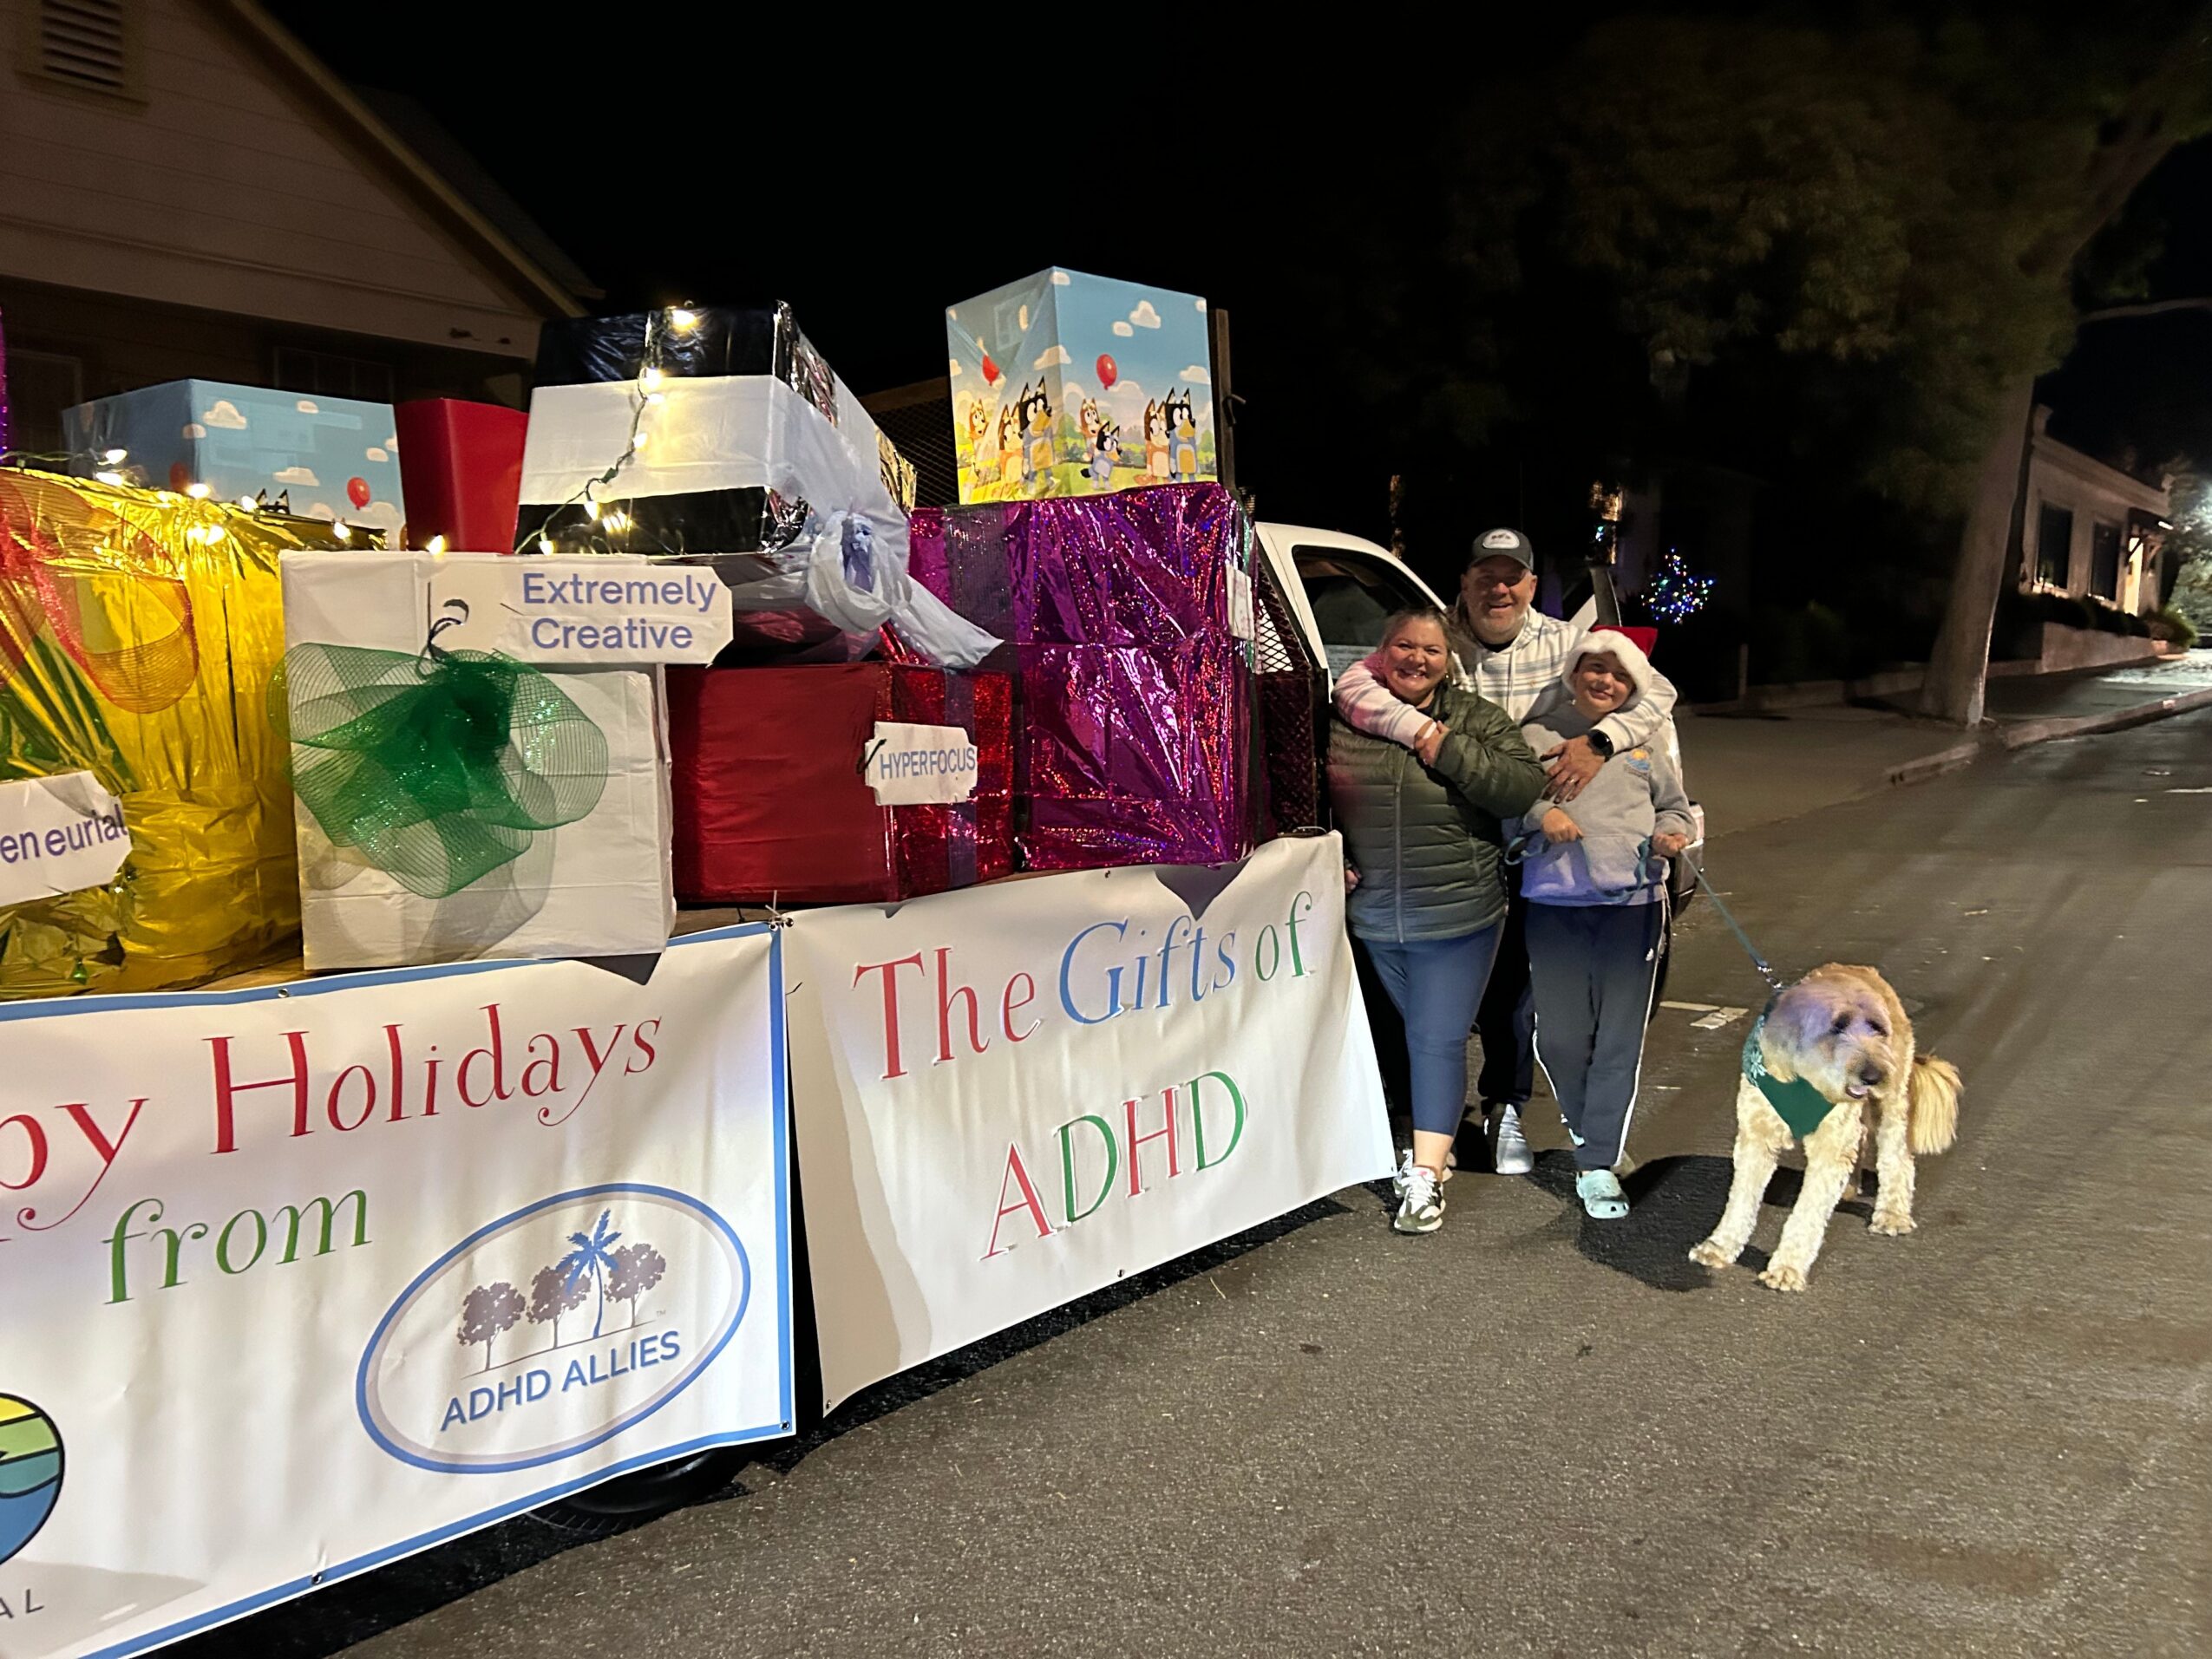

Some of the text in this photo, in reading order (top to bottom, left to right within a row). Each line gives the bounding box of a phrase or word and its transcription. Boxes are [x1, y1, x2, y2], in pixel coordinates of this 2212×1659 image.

[523, 572, 717, 612] Extremely
[532, 617, 693, 650] Creative
[879, 747, 976, 780] HYPERFOCUS
[853, 890, 1312, 1081] The Gifts of
[202, 1003, 662, 1154] Holidays
[978, 1070, 1247, 1260] ADHD
[101, 1189, 373, 1304] from
[440, 1330, 680, 1432] ADHD ALLIES
